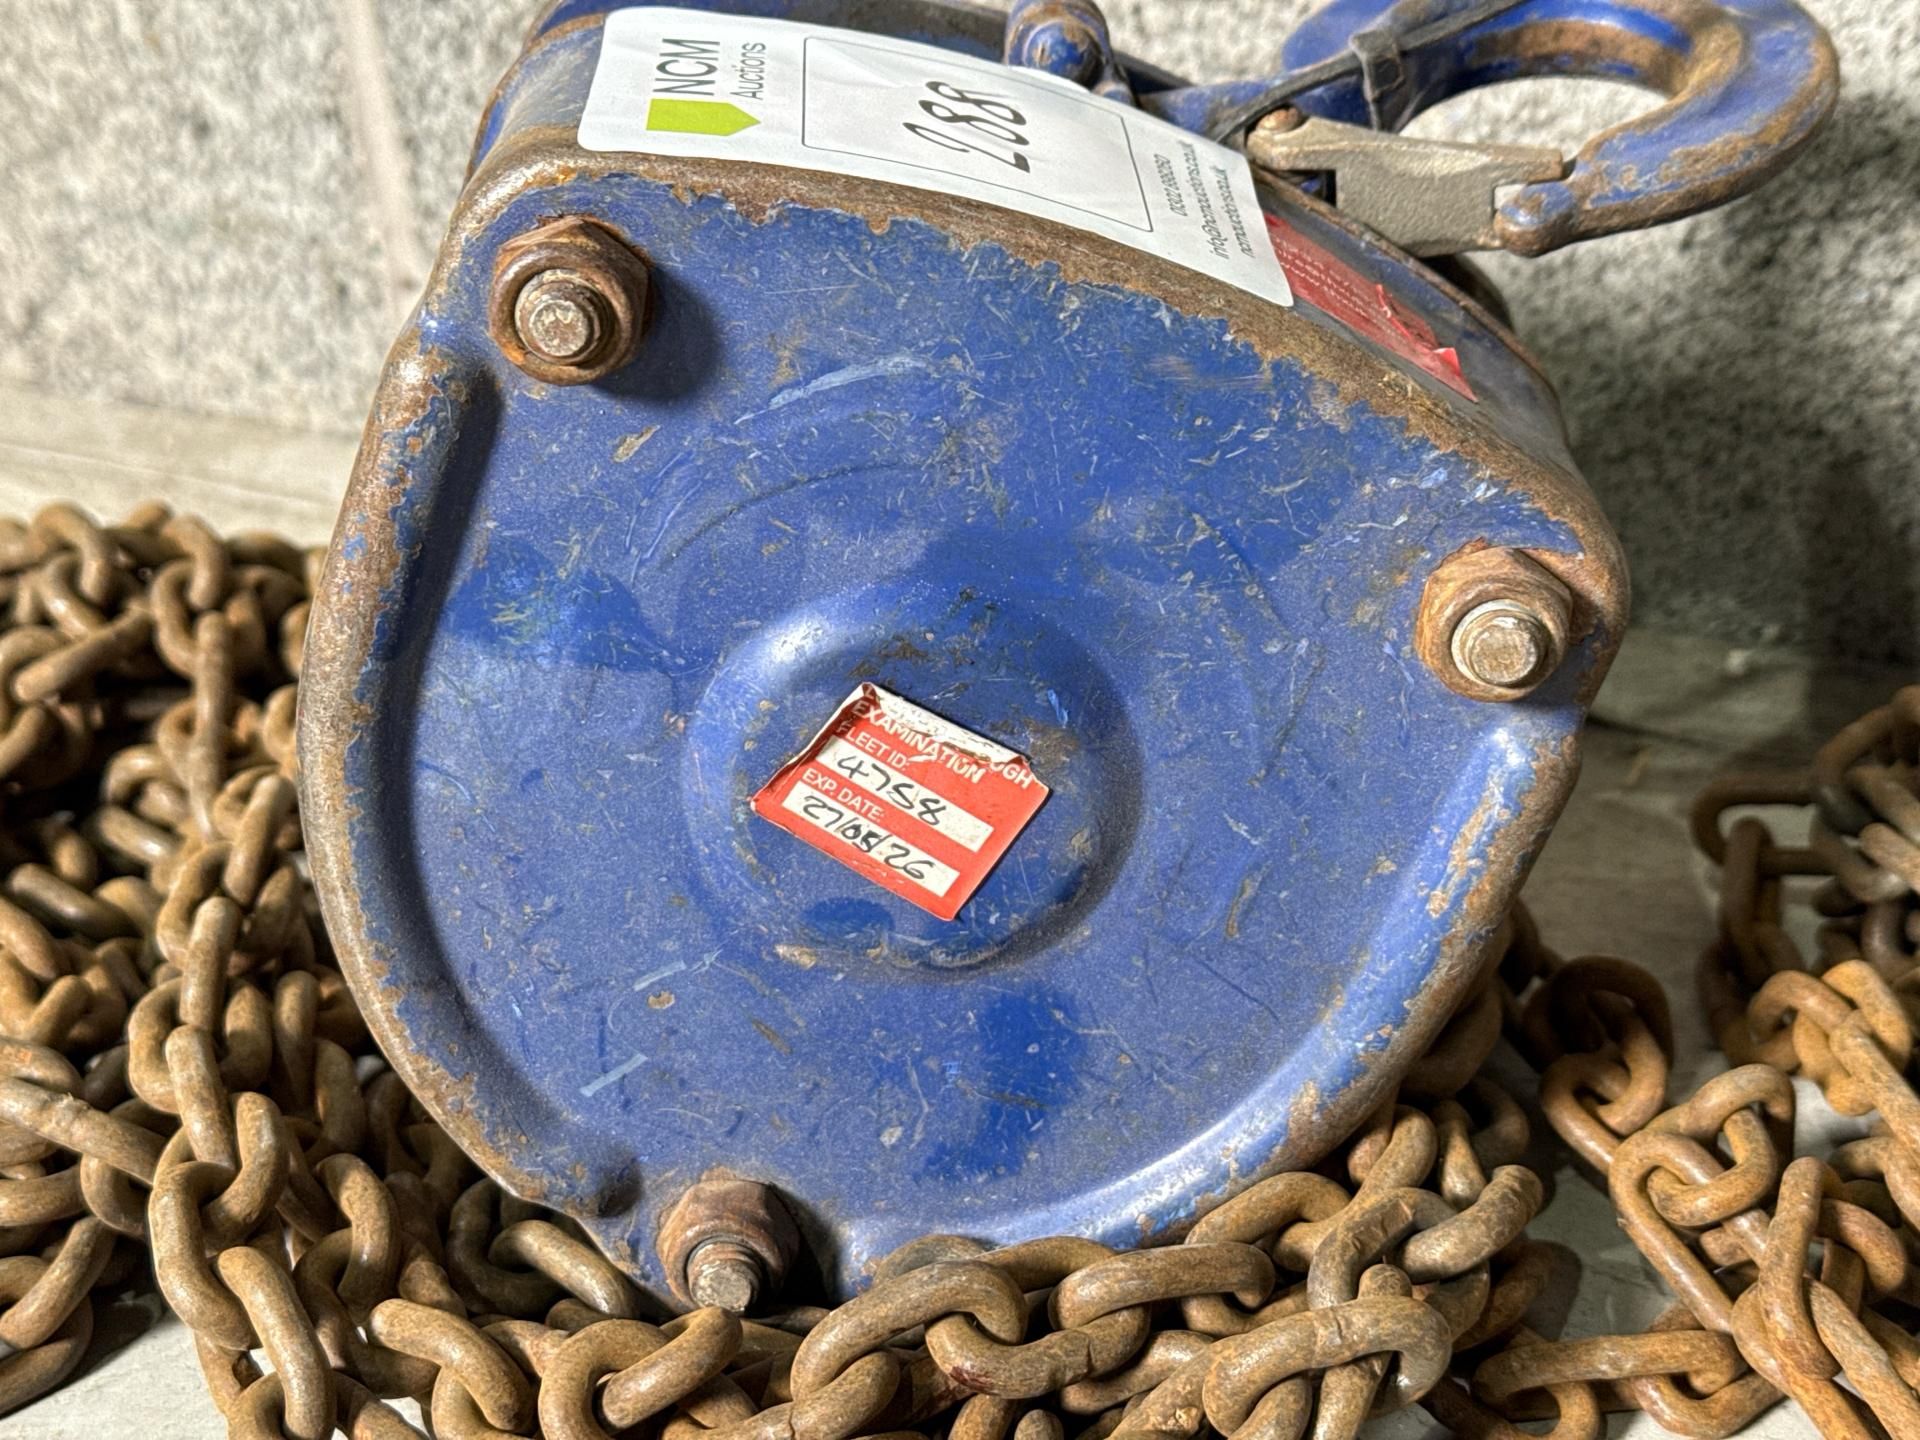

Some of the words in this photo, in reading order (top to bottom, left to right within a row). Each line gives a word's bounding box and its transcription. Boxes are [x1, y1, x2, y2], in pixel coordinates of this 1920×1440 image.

[653, 38, 721, 96] NCM
[730, 42, 767, 100] Auctions
[902, 80, 1031, 174] 288
[836, 720, 888, 756] FLEET
[888, 746, 912, 771] ID:
[851, 700, 987, 785] EXAMINATION
[801, 767, 838, 794] EXP.
[838, 785, 886, 823] DATE:
